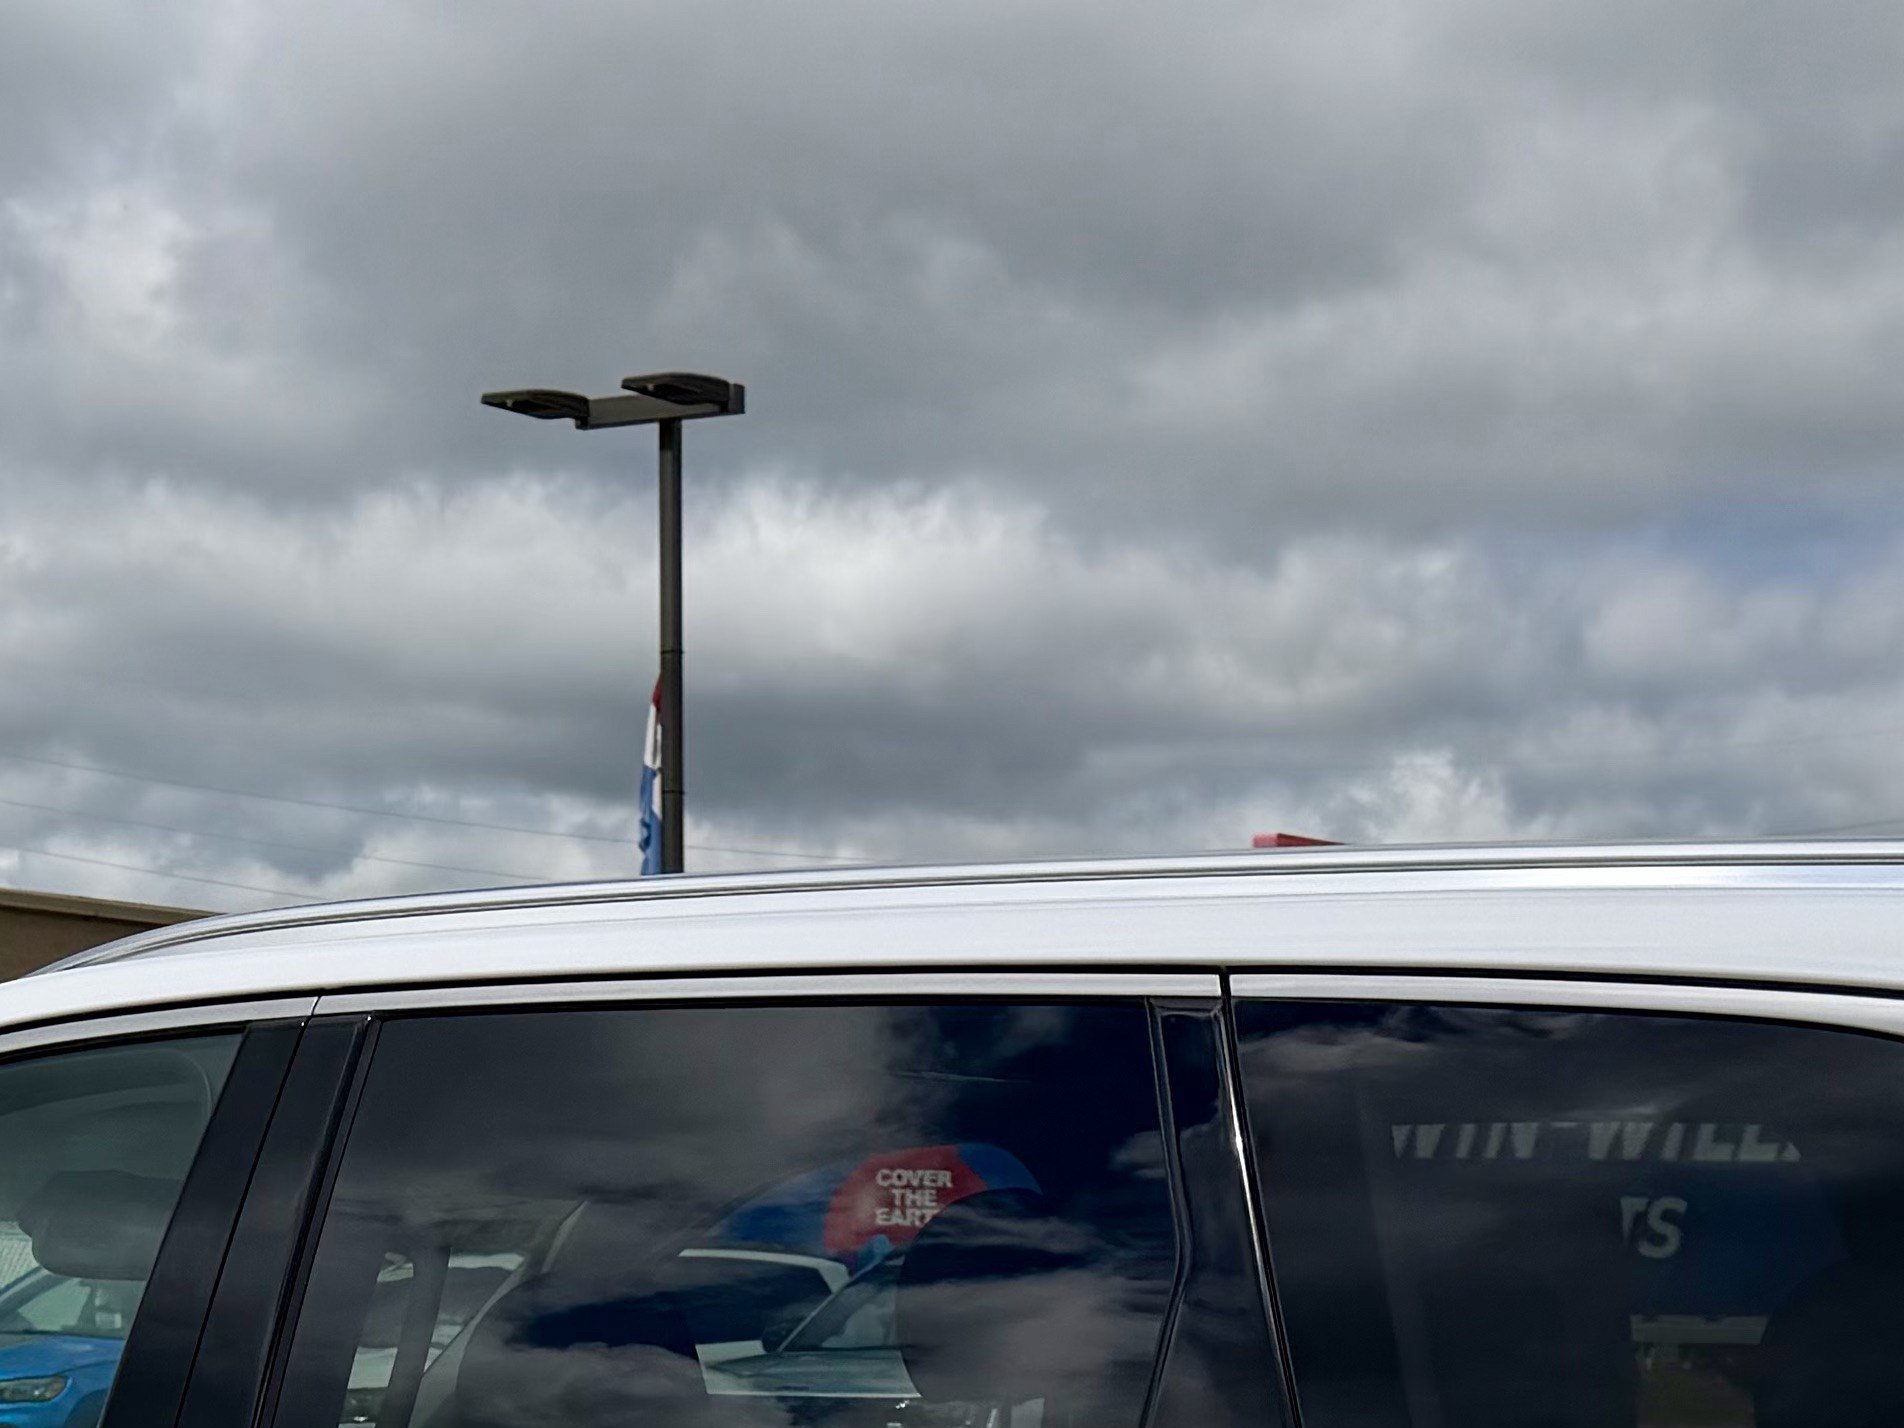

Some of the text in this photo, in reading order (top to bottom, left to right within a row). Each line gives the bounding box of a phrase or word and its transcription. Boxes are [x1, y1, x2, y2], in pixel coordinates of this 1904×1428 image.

[875, 1168, 953, 1189] COVER
[891, 1188, 938, 1207] THE
[875, 1207, 942, 1228] EART
